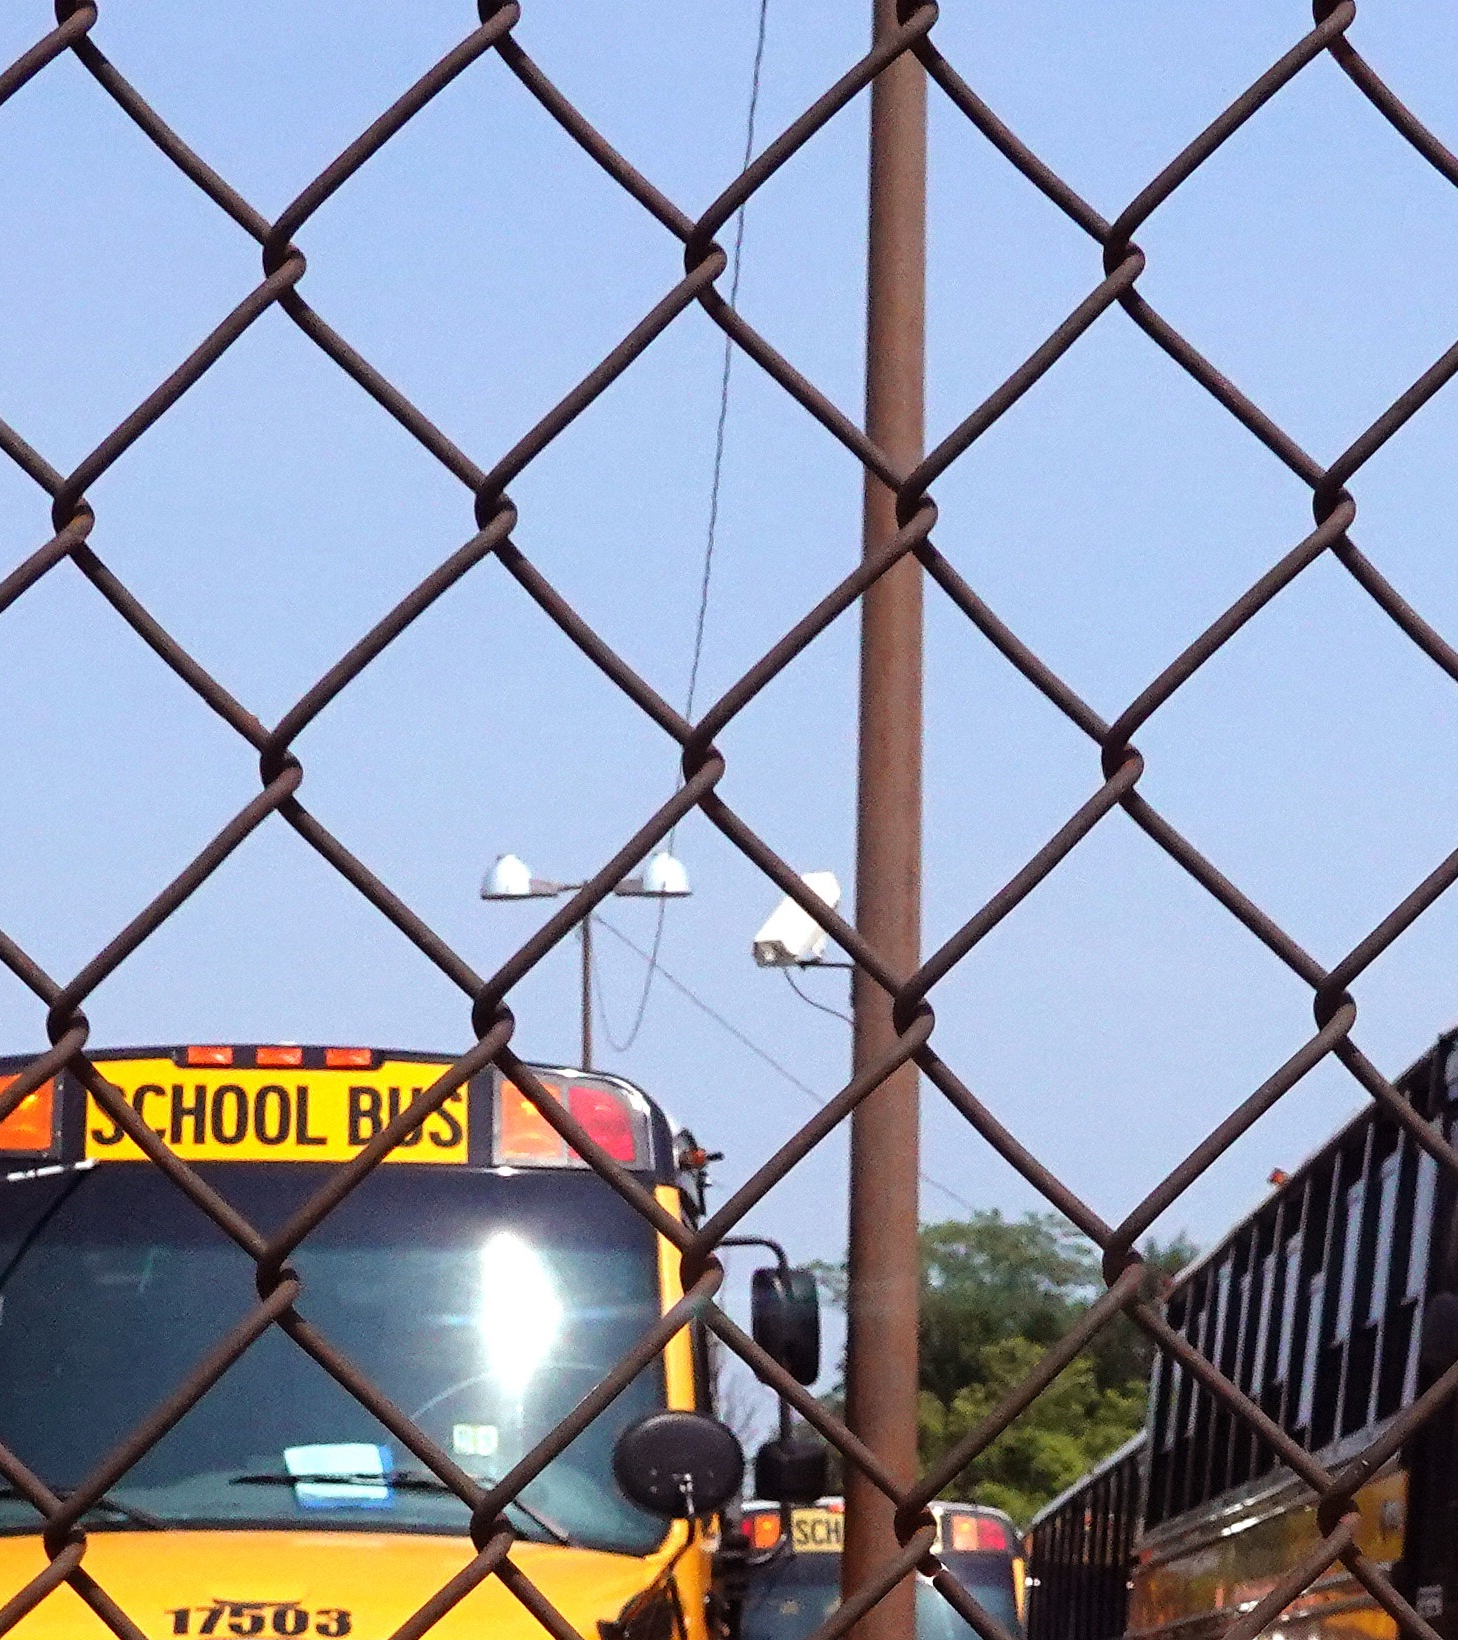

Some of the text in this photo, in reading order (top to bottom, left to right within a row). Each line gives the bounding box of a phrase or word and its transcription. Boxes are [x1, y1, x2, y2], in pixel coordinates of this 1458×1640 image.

[348, 1085, 463, 1148] BUS
[795, 1517, 842, 1546] SCH
[164, 1598, 352, 1638] 17503
